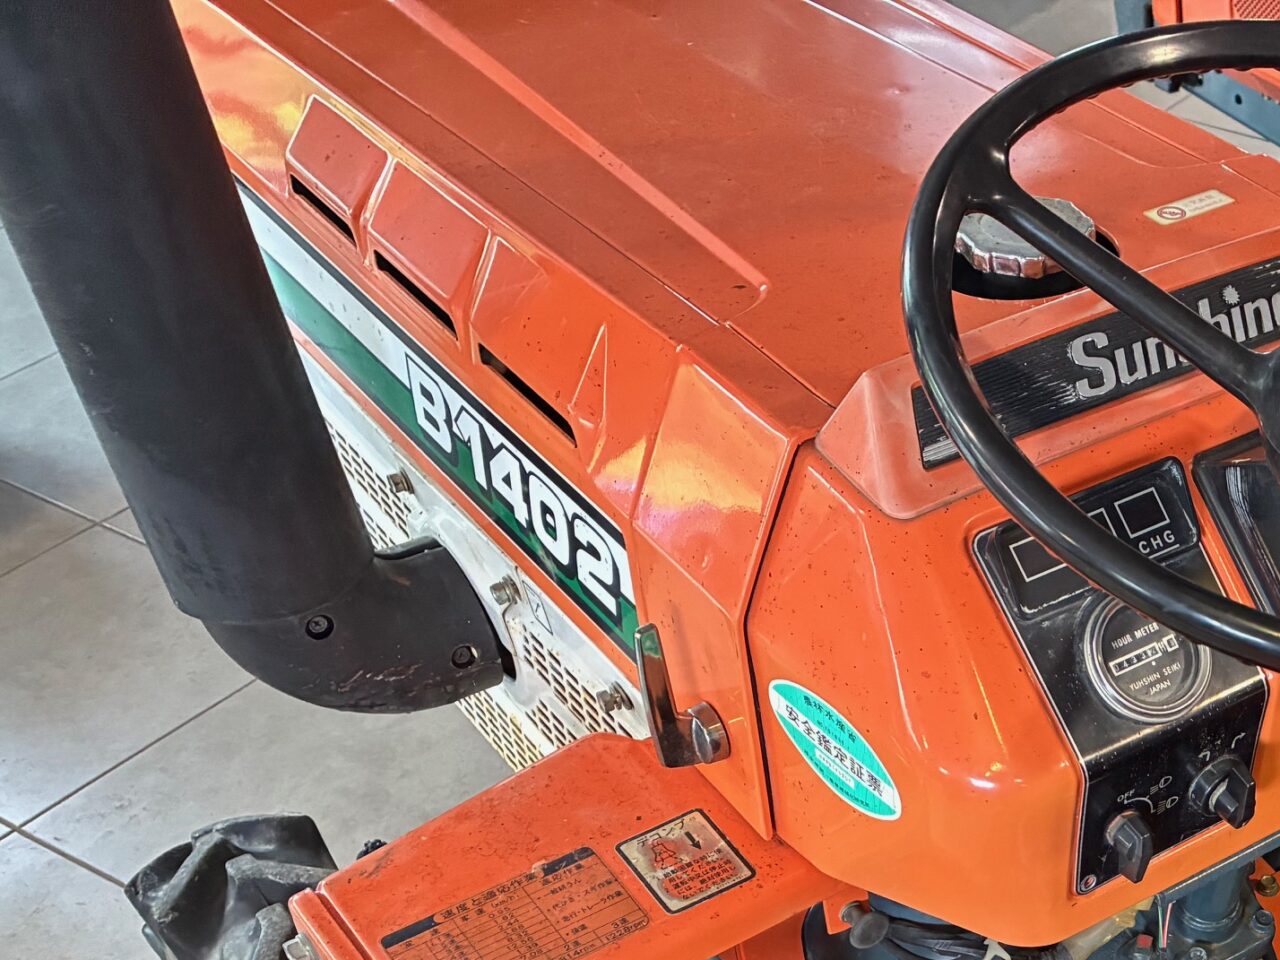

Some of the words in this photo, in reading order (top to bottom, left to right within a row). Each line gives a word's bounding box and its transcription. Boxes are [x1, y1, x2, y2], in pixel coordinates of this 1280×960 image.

[406, 354, 619, 622] B1402
[1138, 530, 1176, 555] CHG
[1111, 634, 1133, 650] HOUR
[1134, 622, 1160, 639] METER
[1129, 671, 1161, 691] YUHSHIN
[1163, 662, 1182, 677] SEIKI
[1148, 680, 1171, 696] JAPAN
[1117, 788, 1136, 802] OFF
